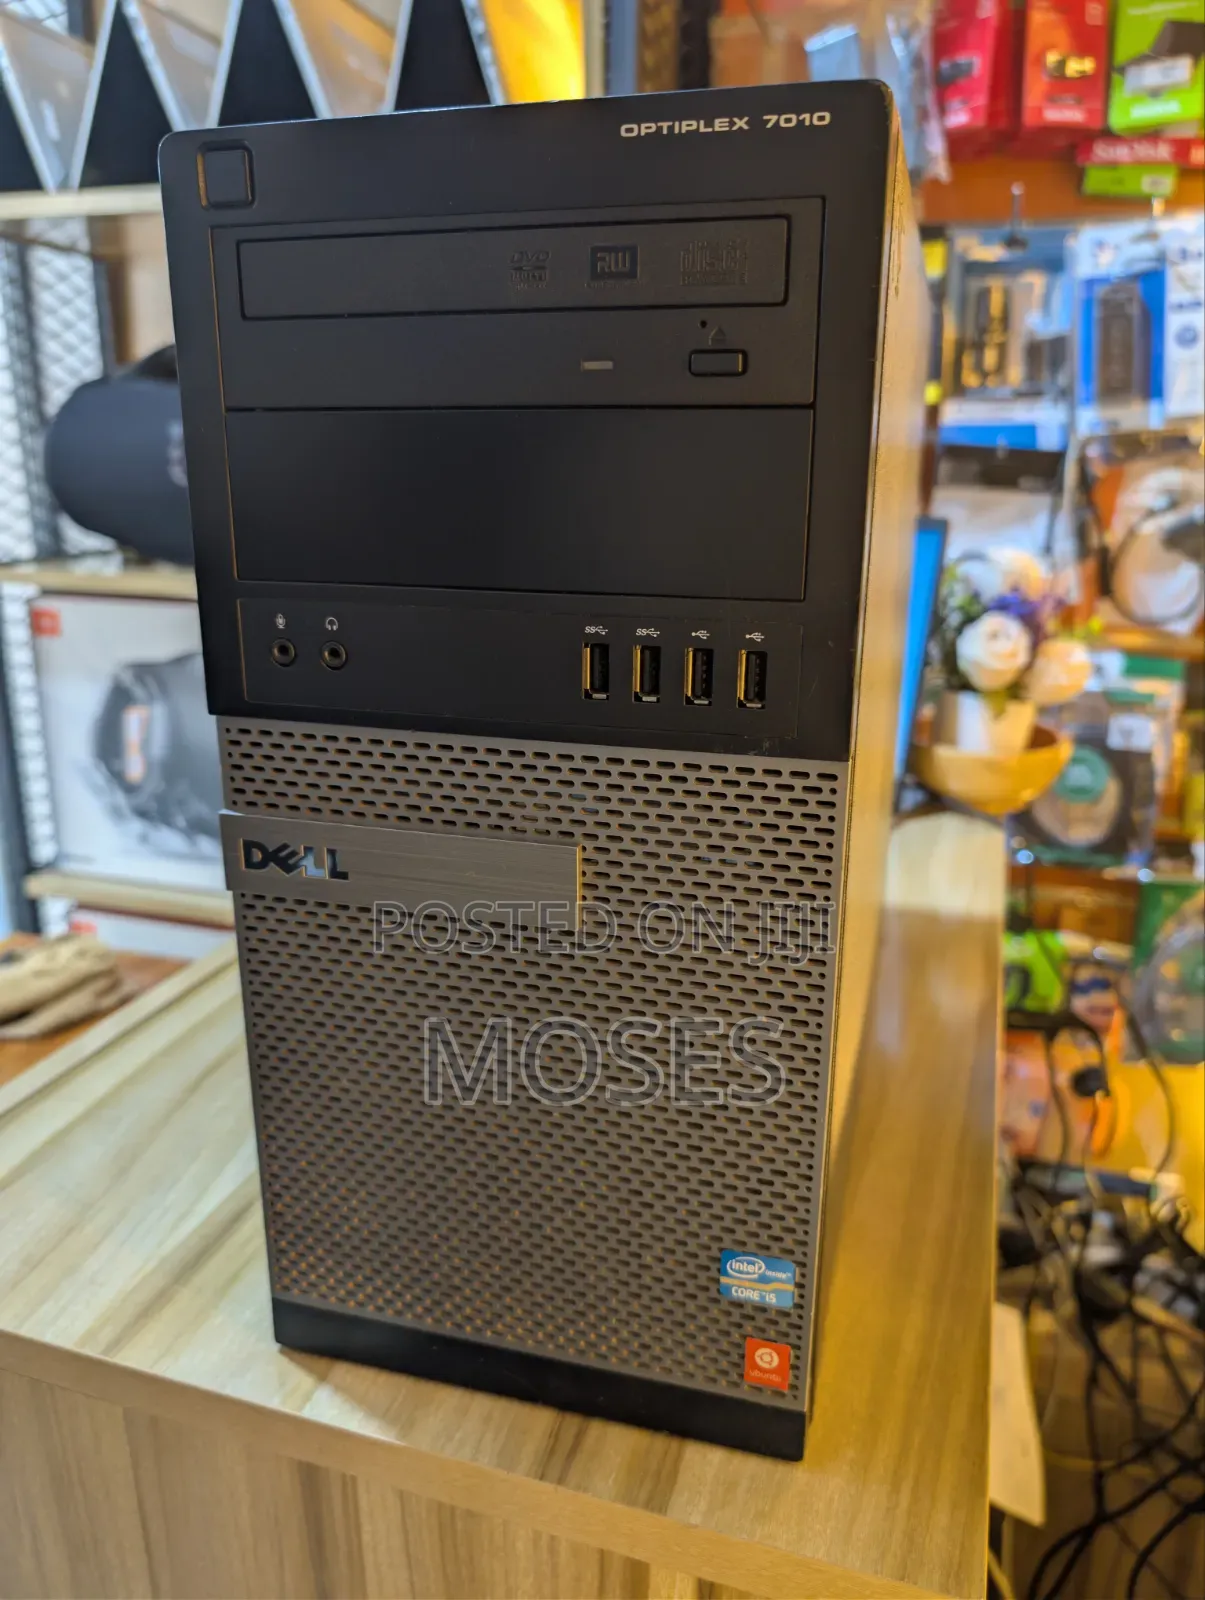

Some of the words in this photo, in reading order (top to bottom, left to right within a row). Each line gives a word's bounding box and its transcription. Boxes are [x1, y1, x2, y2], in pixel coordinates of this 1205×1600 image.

[620, 116, 750, 138] OPTIPLEX
[763, 111, 832, 129] 7010
[597, 250, 631, 273] RW
[238, 837, 349, 881] DELL
[731, 1258, 760, 1274] intel
[749, 1368, 782, 1383] ubuntu
